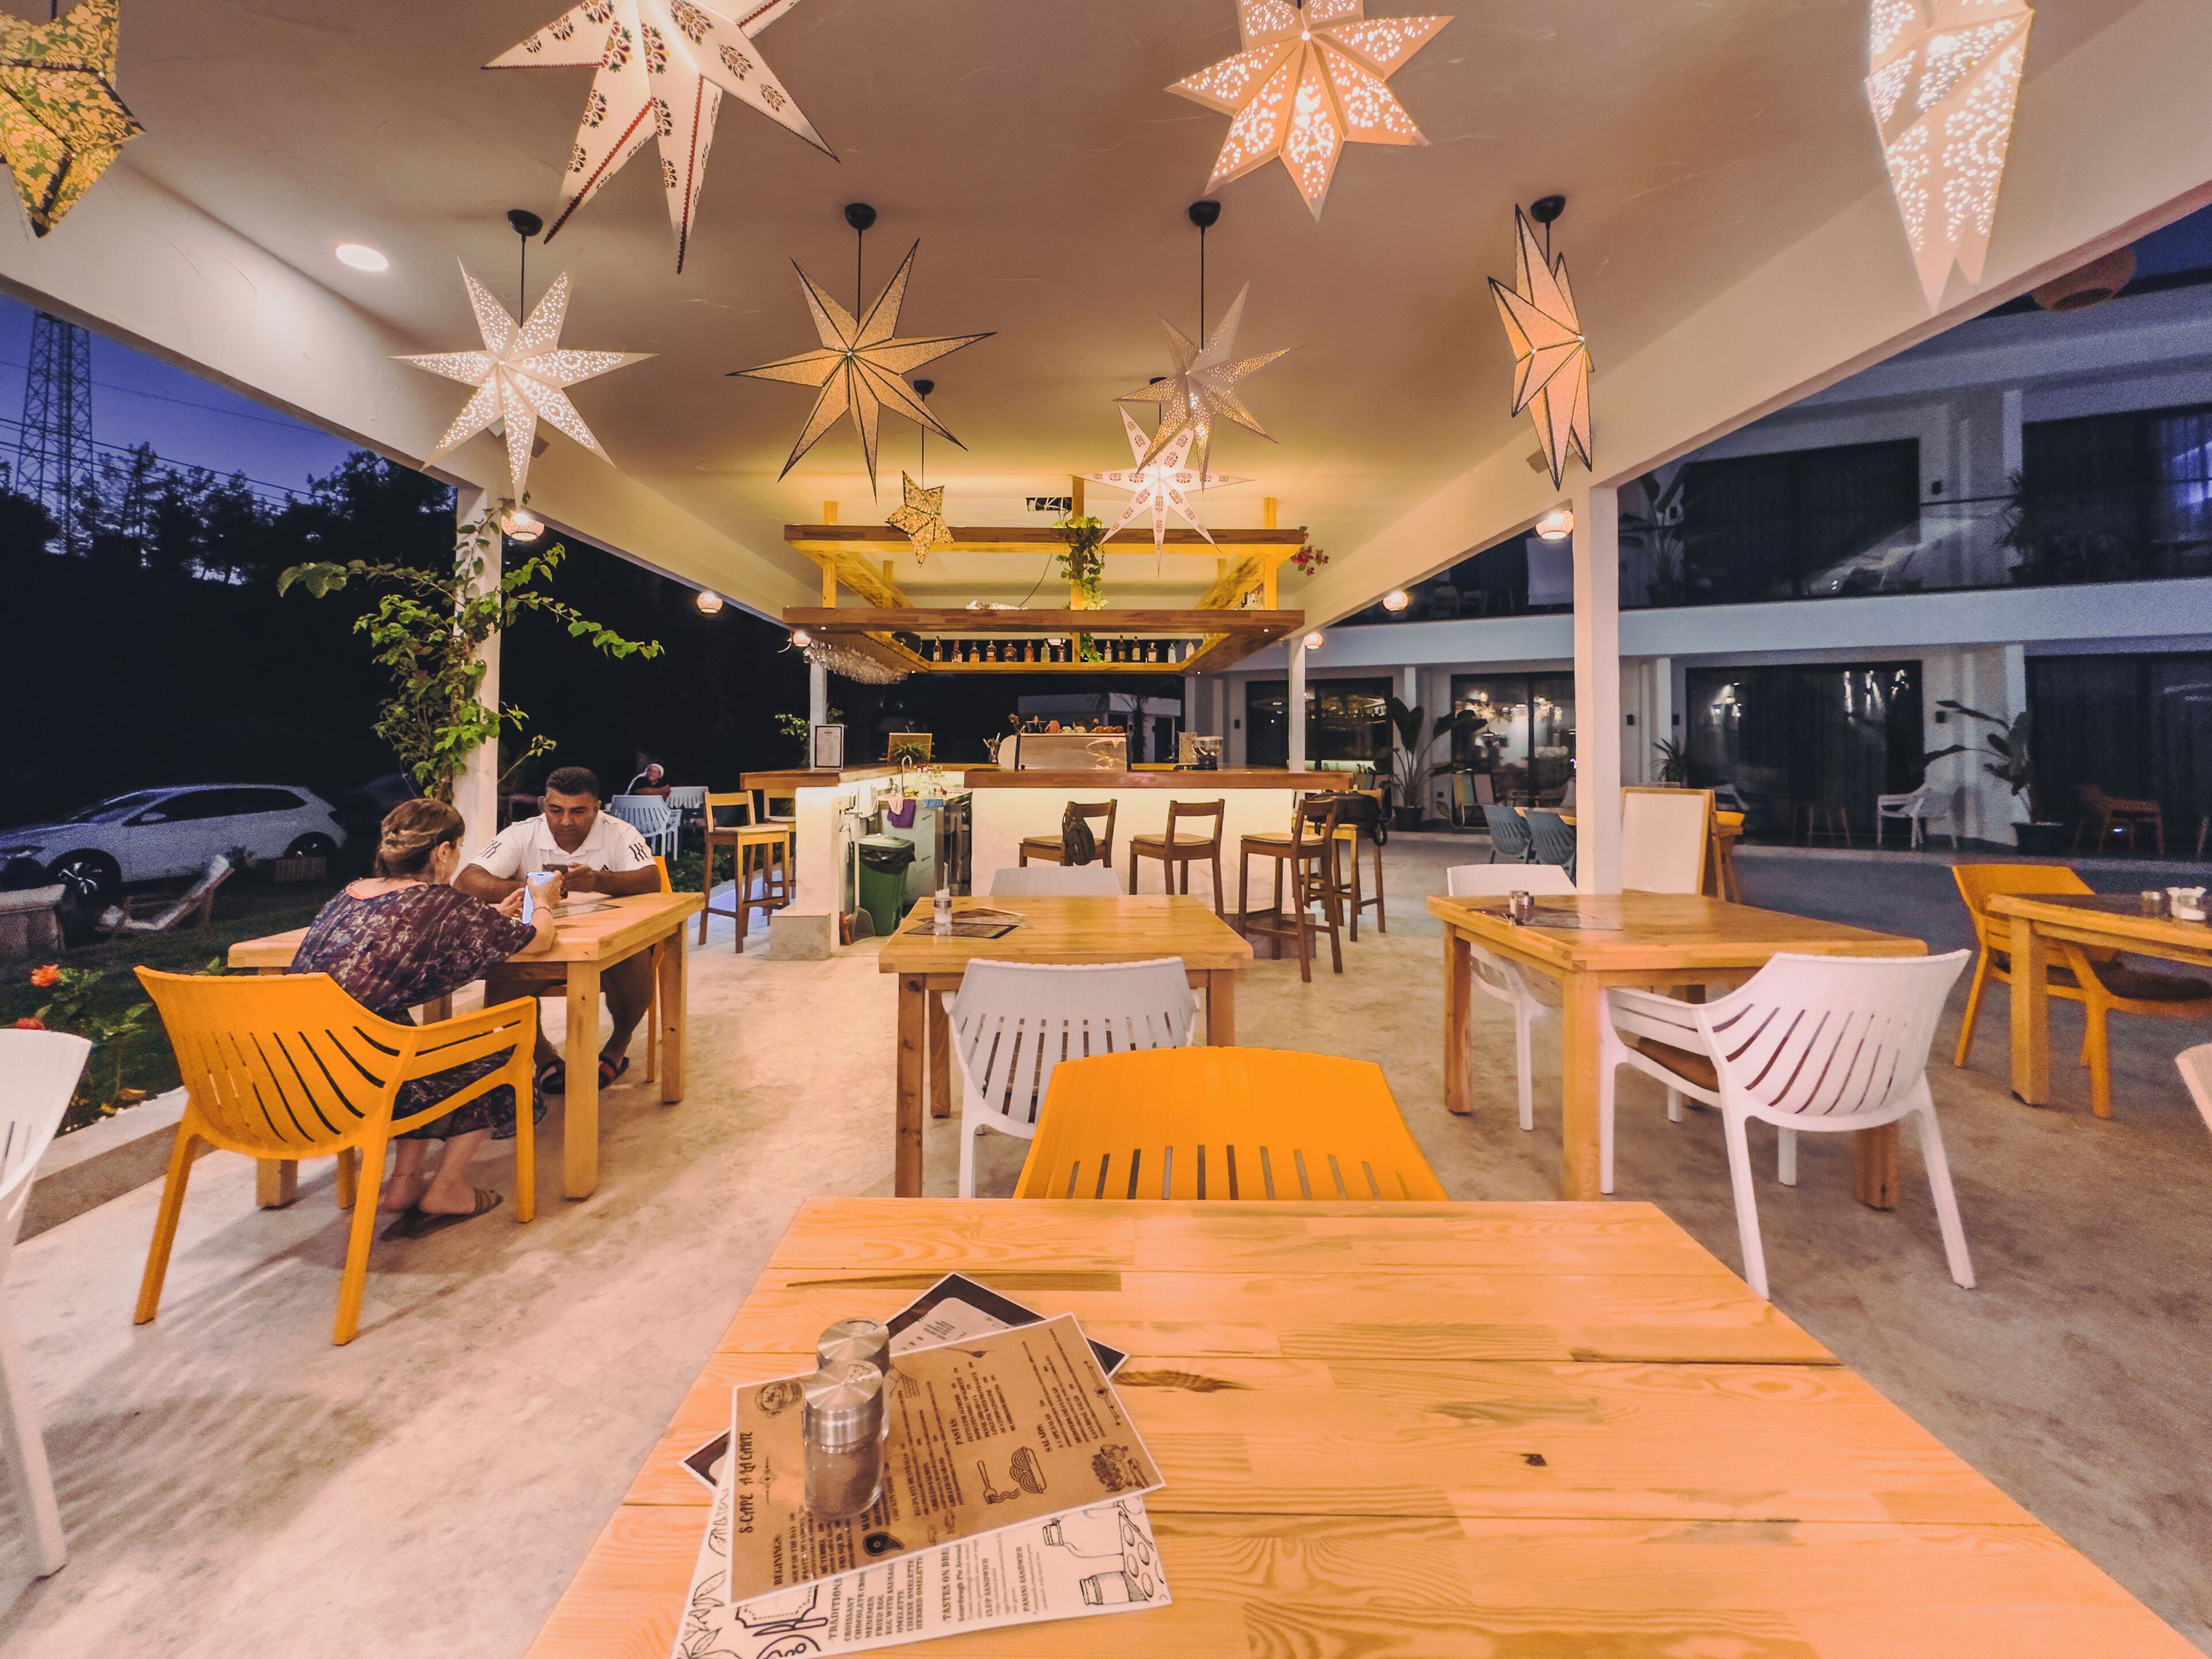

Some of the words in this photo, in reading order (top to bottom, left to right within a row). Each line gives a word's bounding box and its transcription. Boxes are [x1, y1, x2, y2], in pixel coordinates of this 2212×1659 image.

[738, 1491, 755, 1535] S-CAPE
[981, 1558, 991, 1596] SANDWICH
[1016, 1546, 1026, 1584] SANDWICH
[844, 1596, 853, 1641] CROISSANT
[854, 1592, 863, 1639] CHOCOLATE
[865, 1596, 873, 1638] MENEMEN
